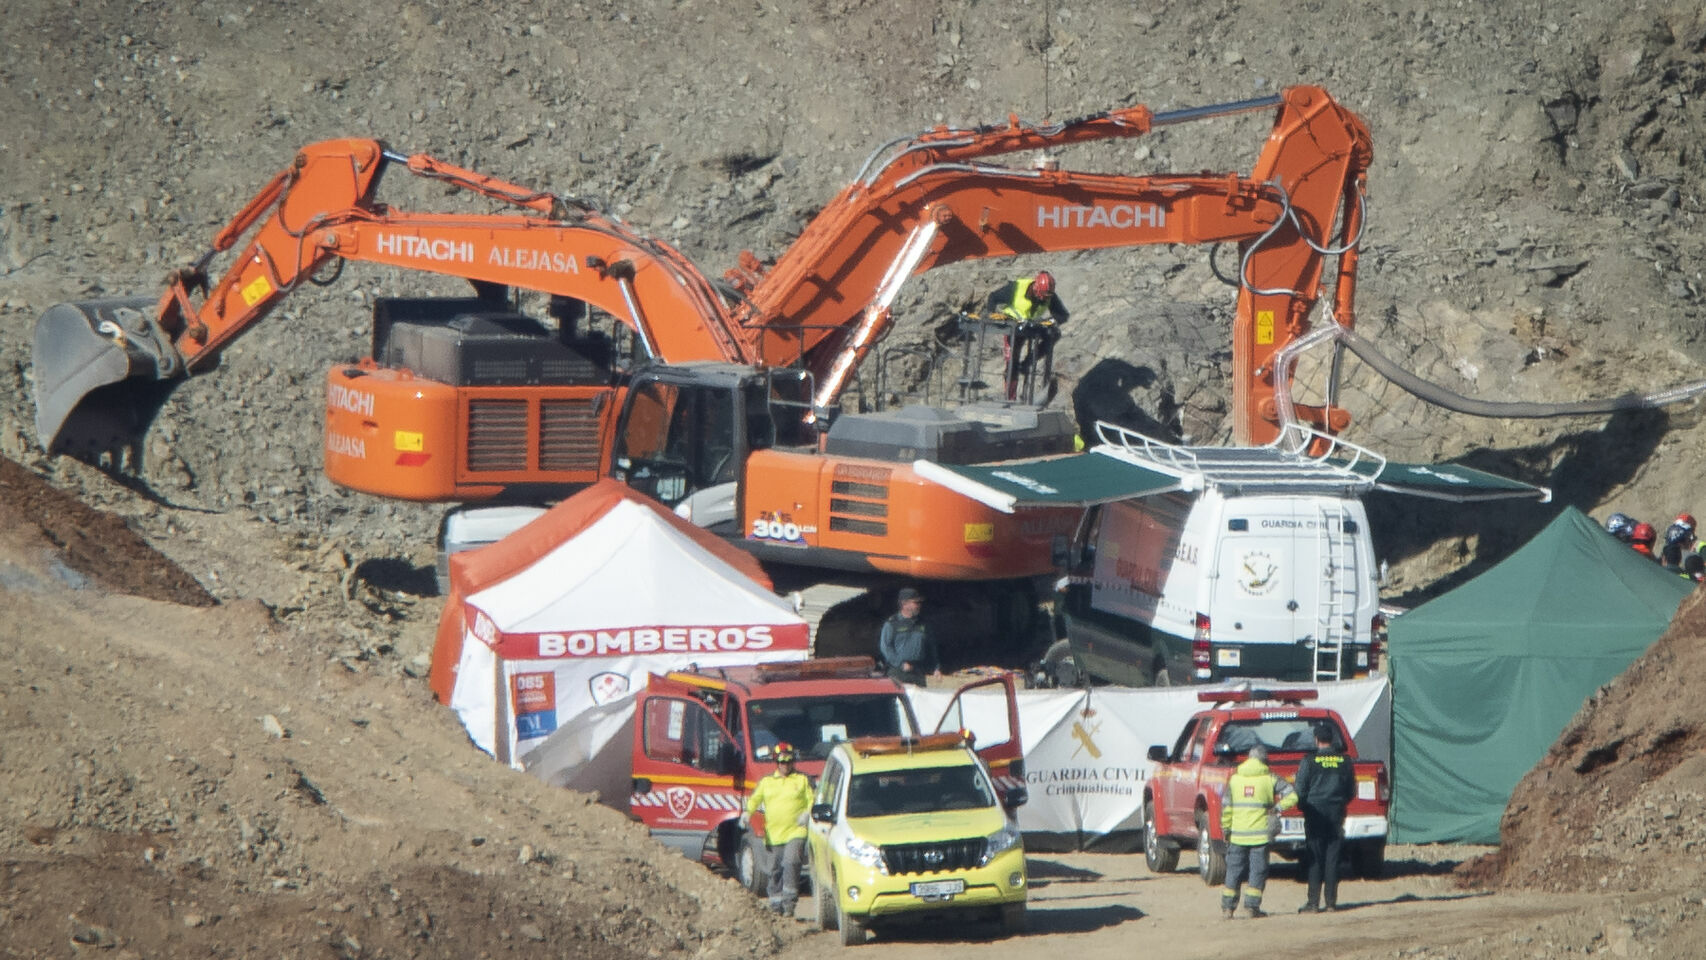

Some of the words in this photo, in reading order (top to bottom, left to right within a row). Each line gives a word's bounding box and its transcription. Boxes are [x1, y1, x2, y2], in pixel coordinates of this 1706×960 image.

[1037, 205, 1166, 228] HITACHI
[377, 233, 475, 263] HITACHI
[488, 246, 579, 275] ALEJASA
[752, 519, 800, 542] 300
[539, 626, 773, 657] BOMBEROS
[1026, 768, 1098, 784] GUARDIA
[1102, 767, 1147, 781] CIVIL
